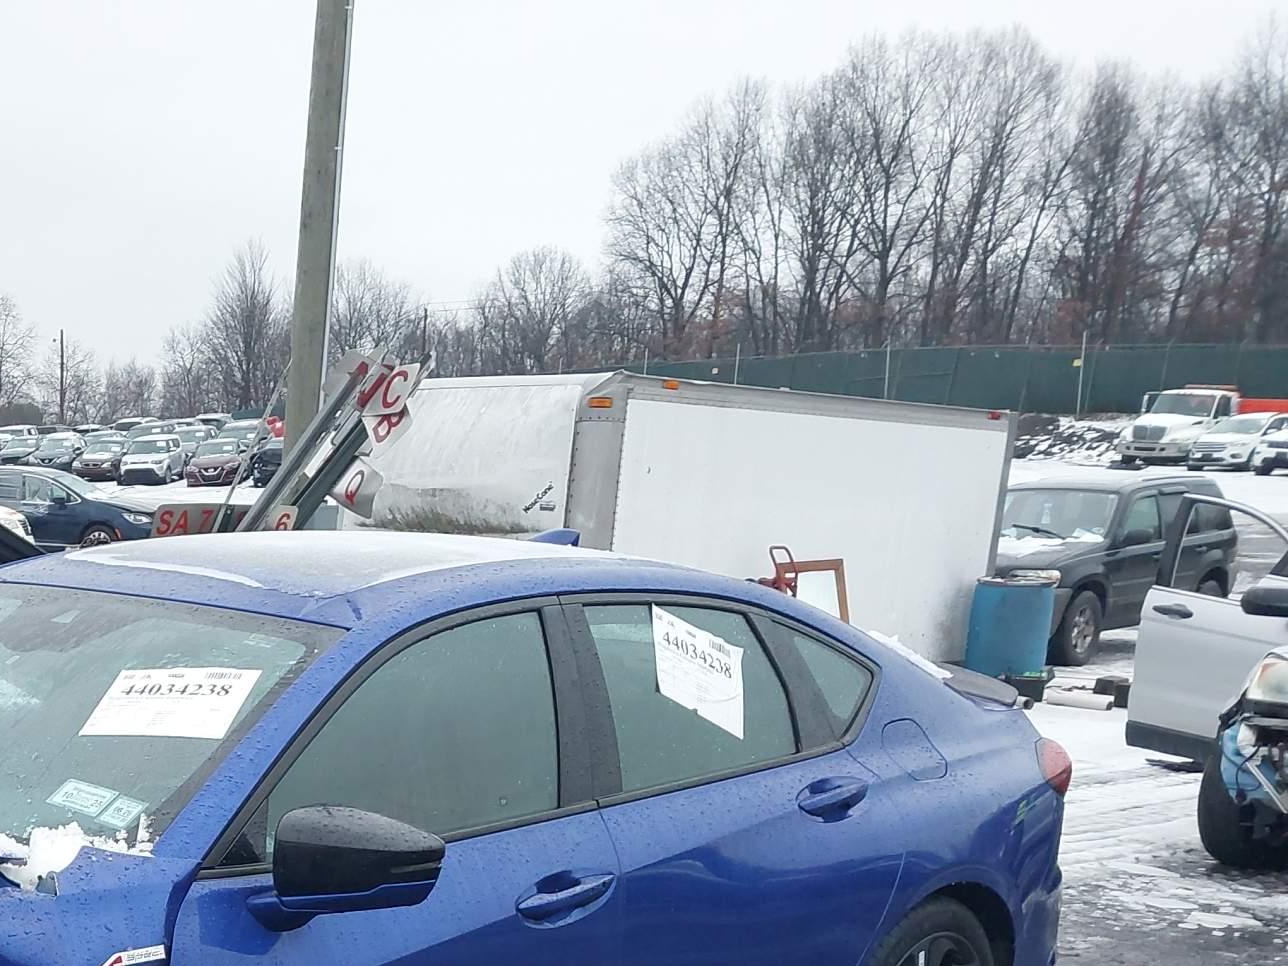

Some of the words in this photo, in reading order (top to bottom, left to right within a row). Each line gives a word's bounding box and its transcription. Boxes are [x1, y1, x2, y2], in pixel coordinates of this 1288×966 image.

[382, 370, 409, 409] C
[344, 469, 365, 505] Q
[156, 509, 189, 536] SA
[662, 631, 732, 679] 44034238
[121, 683, 232, 697] 44034238
